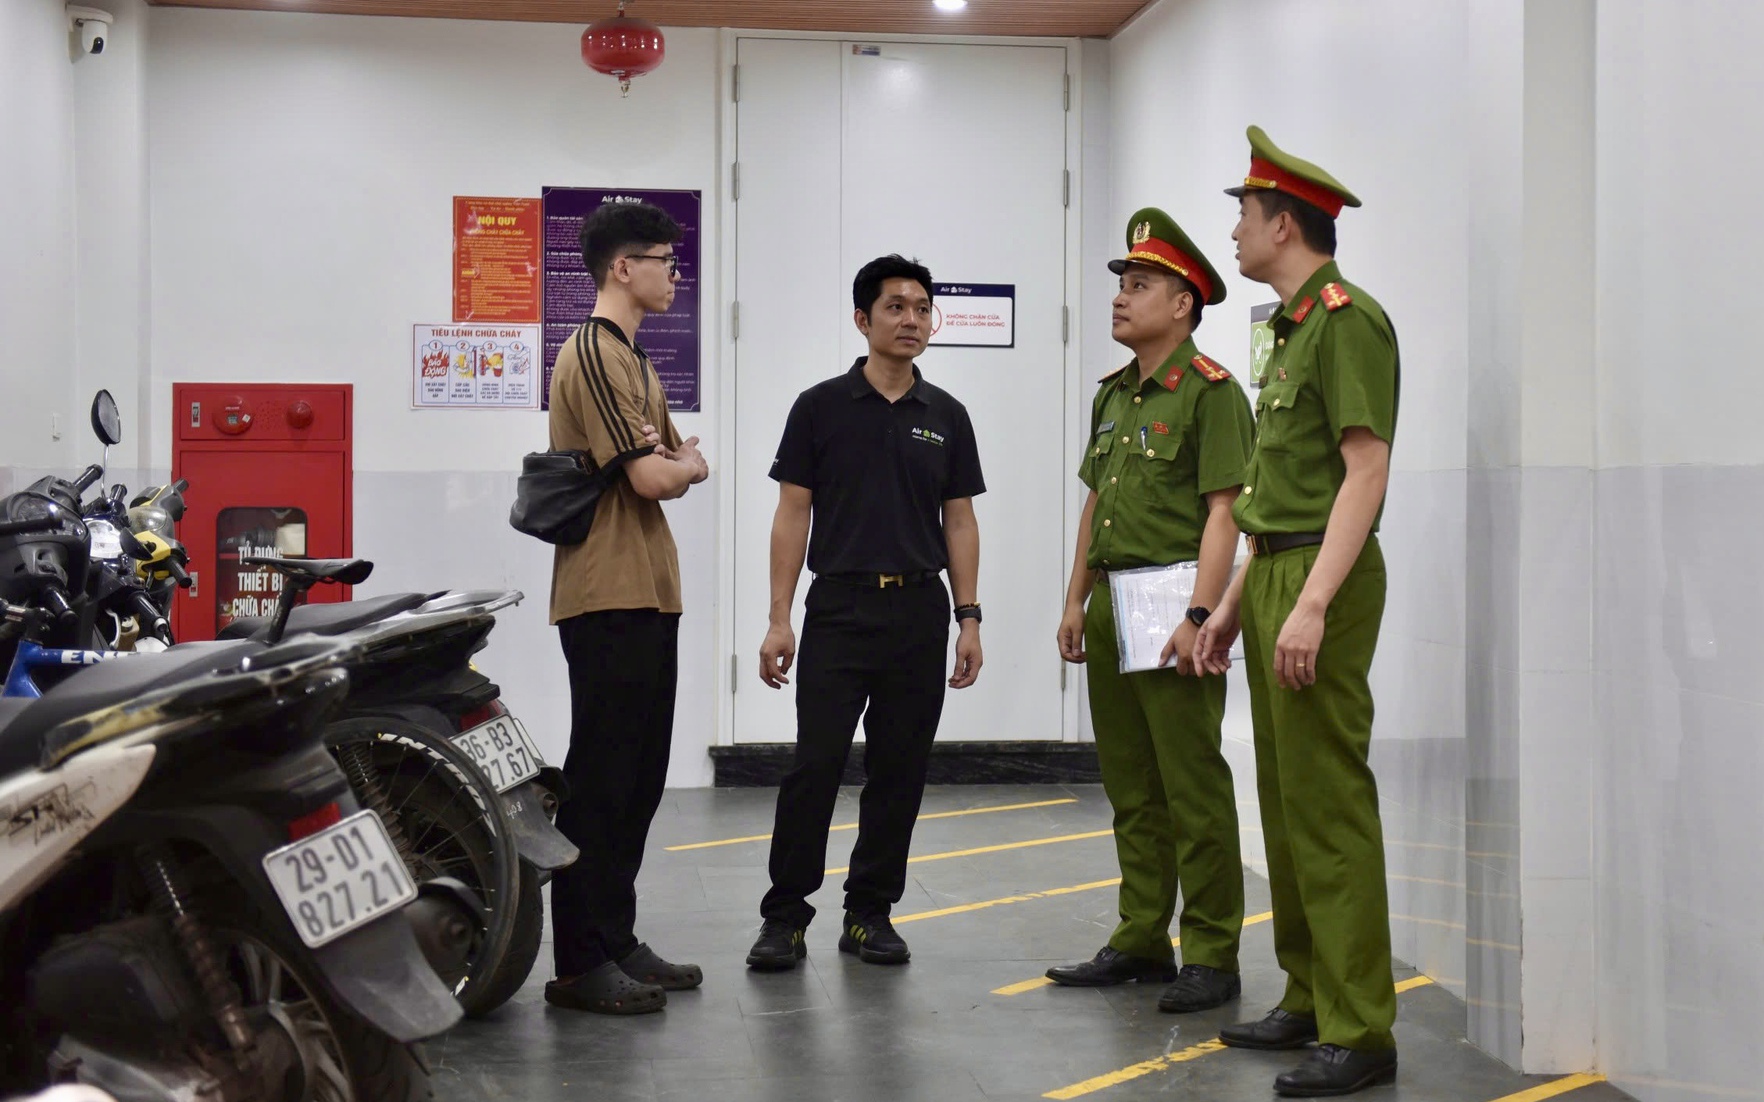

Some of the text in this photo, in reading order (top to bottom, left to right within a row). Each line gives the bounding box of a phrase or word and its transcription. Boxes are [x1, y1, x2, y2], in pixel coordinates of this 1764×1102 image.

[624, 196, 642, 204] Stay
[478, 214, 517, 226] NỘI QUY
[432, 328, 522, 338] TIÊU LỆNH CHỮA CHÁY
[931, 432, 945, 442] Stay
[238, 540, 251, 565] TỦ
[238, 566, 269, 592] THIẾT
[232, 594, 280, 617] CHỮA CHÁ
[460, 722, 513, 762] 36-B3
[285, 826, 374, 893] 29-D1
[298, 861, 404, 937] 827.21
